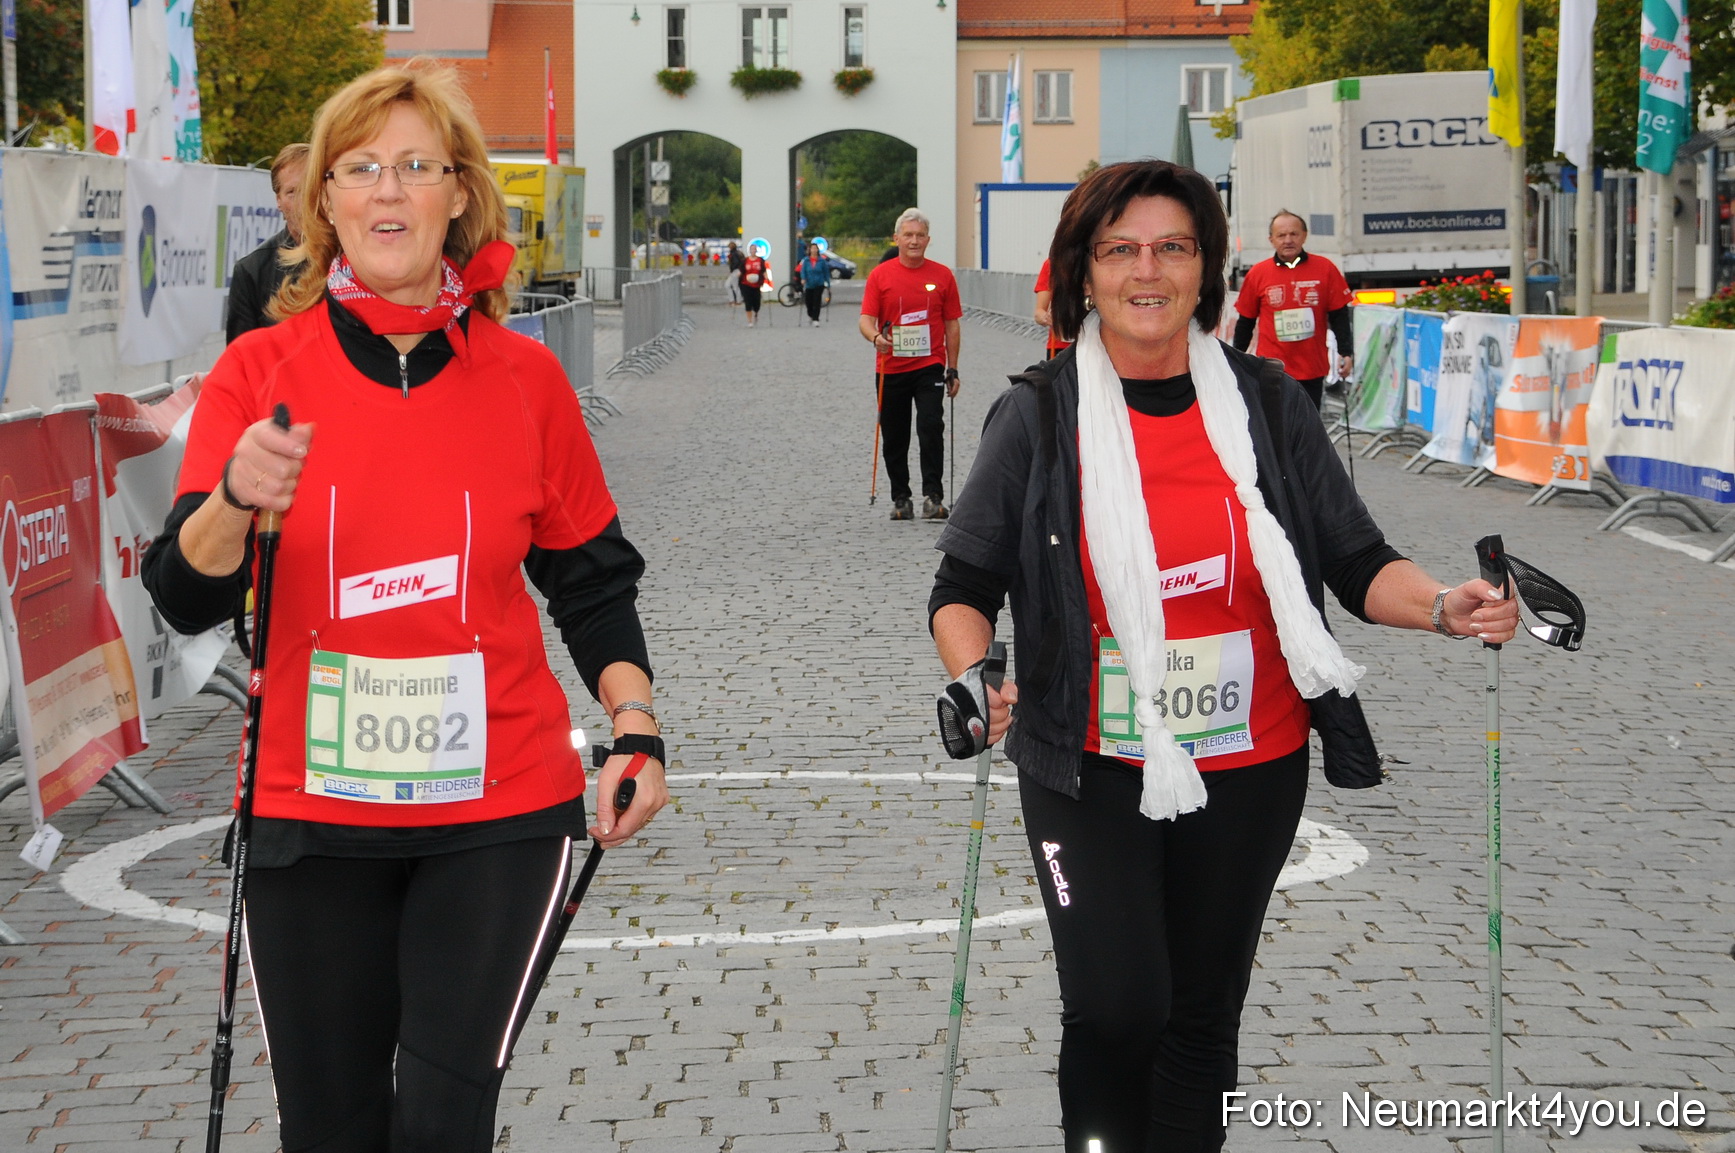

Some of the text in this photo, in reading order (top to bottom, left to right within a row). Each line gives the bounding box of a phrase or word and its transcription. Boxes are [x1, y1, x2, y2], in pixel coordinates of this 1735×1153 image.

[1361, 117, 1503, 150] BOCK
[1368, 214, 1503, 231] www.bockonline.de
[1286, 319, 1311, 331] 8010
[902, 336, 928, 347] 8075
[372, 574, 426, 601] DEHN
[354, 667, 459, 697] Marianne
[355, 711, 470, 753] 8082
[1196, 731, 1249, 750] PFLEIDERER
[1116, 743, 1144, 754] BOC
[323, 778, 369, 794] BOCK
[416, 777, 481, 793] PFLEIDERER
[1048, 859, 1071, 907] odlo
